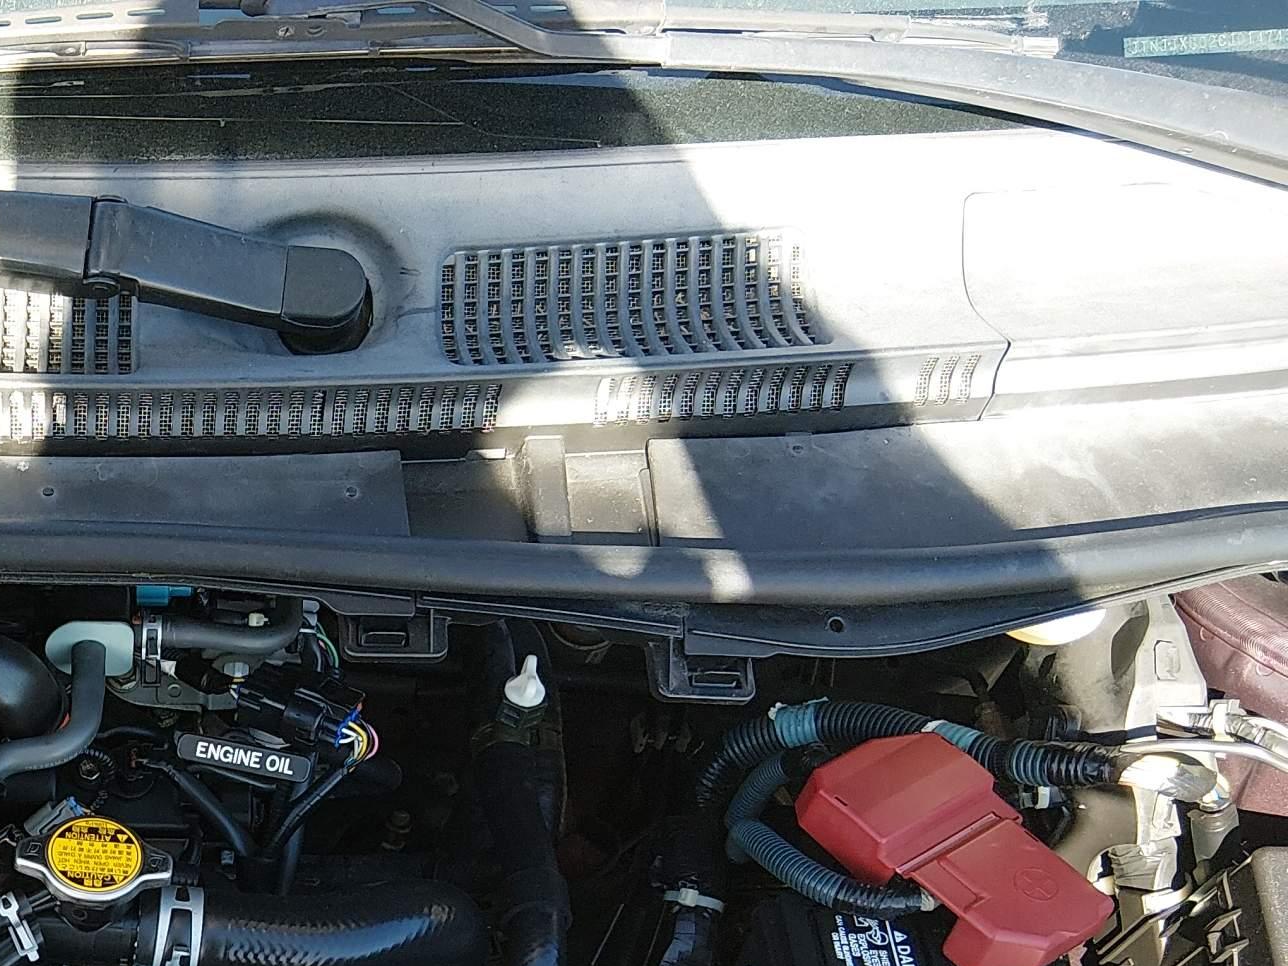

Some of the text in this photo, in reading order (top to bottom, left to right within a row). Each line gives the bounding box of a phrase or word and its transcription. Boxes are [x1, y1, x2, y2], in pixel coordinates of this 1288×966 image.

[195, 741, 294, 776] ENGINE OIL
[65, 832, 111, 842] ATTENTION
[67, 871, 111, 881] CAUTION
[848, 934, 860, 957] GASES
[870, 950, 881, 966] EYES
